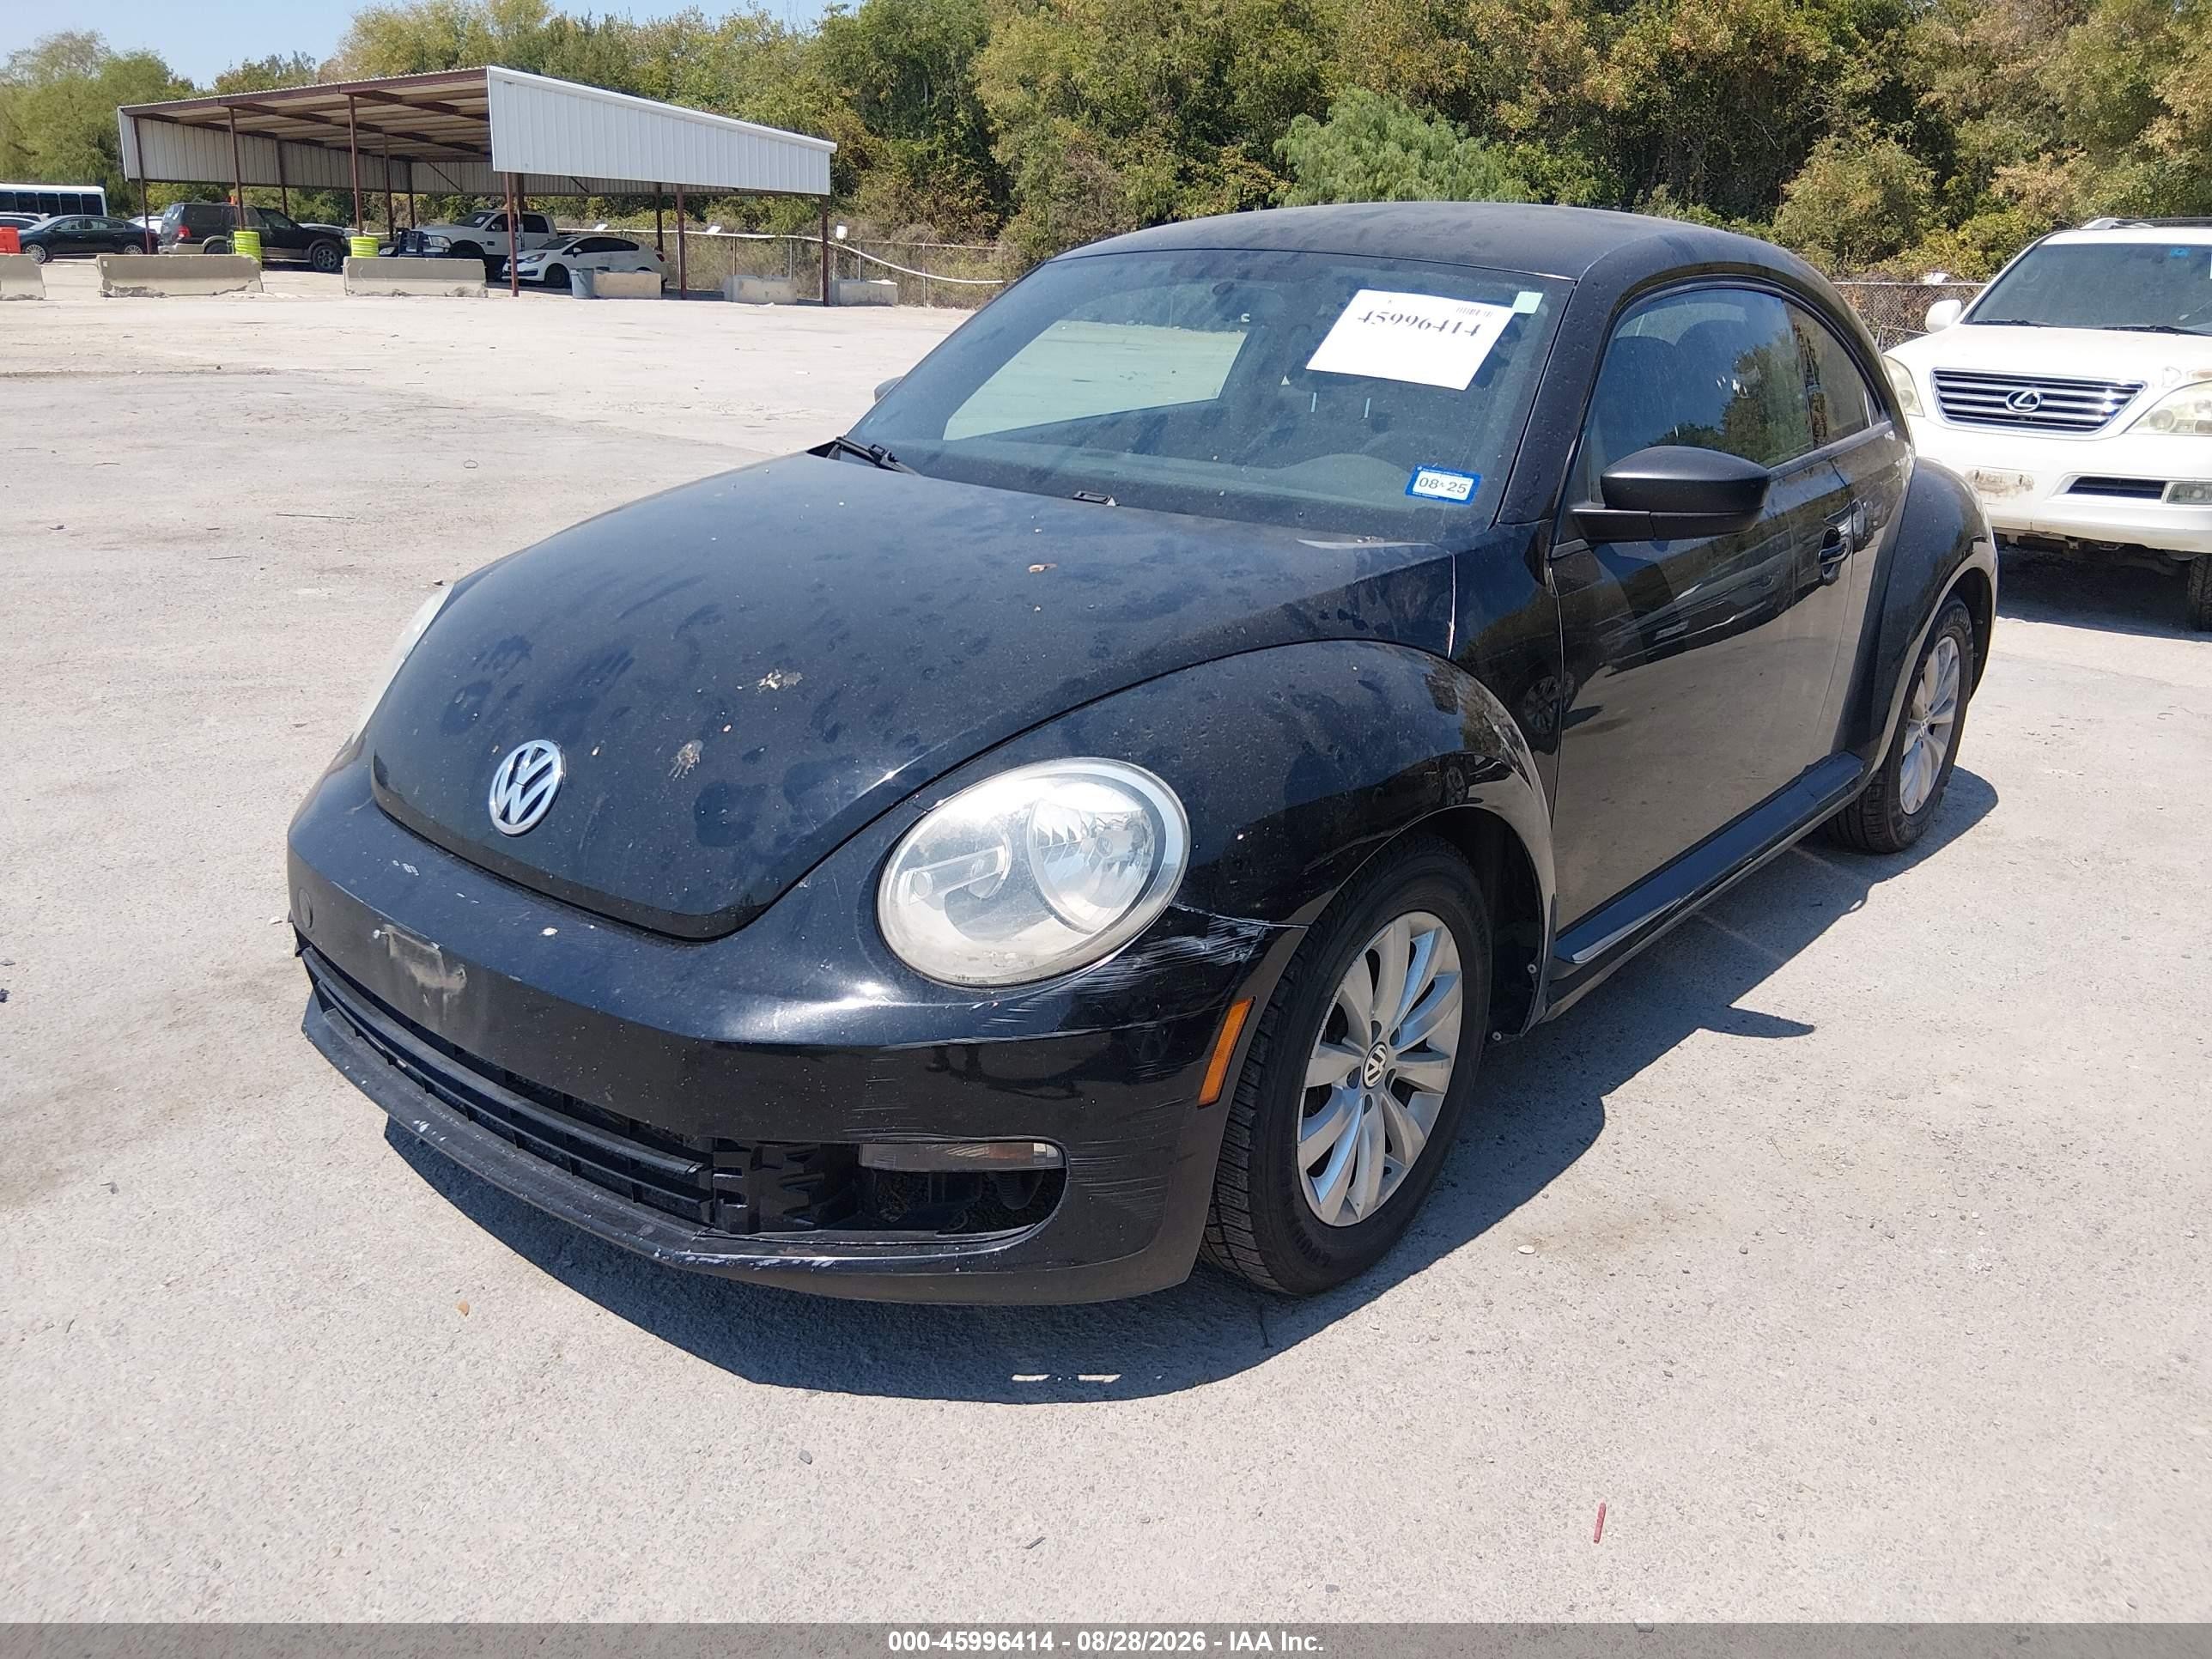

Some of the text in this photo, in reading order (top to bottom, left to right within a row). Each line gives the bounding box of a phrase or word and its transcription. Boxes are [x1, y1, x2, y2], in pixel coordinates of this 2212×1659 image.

[1357, 309, 1482, 337] 45996414
[1419, 477, 1468, 494] 08 25
[489, 739, 564, 836] VW
